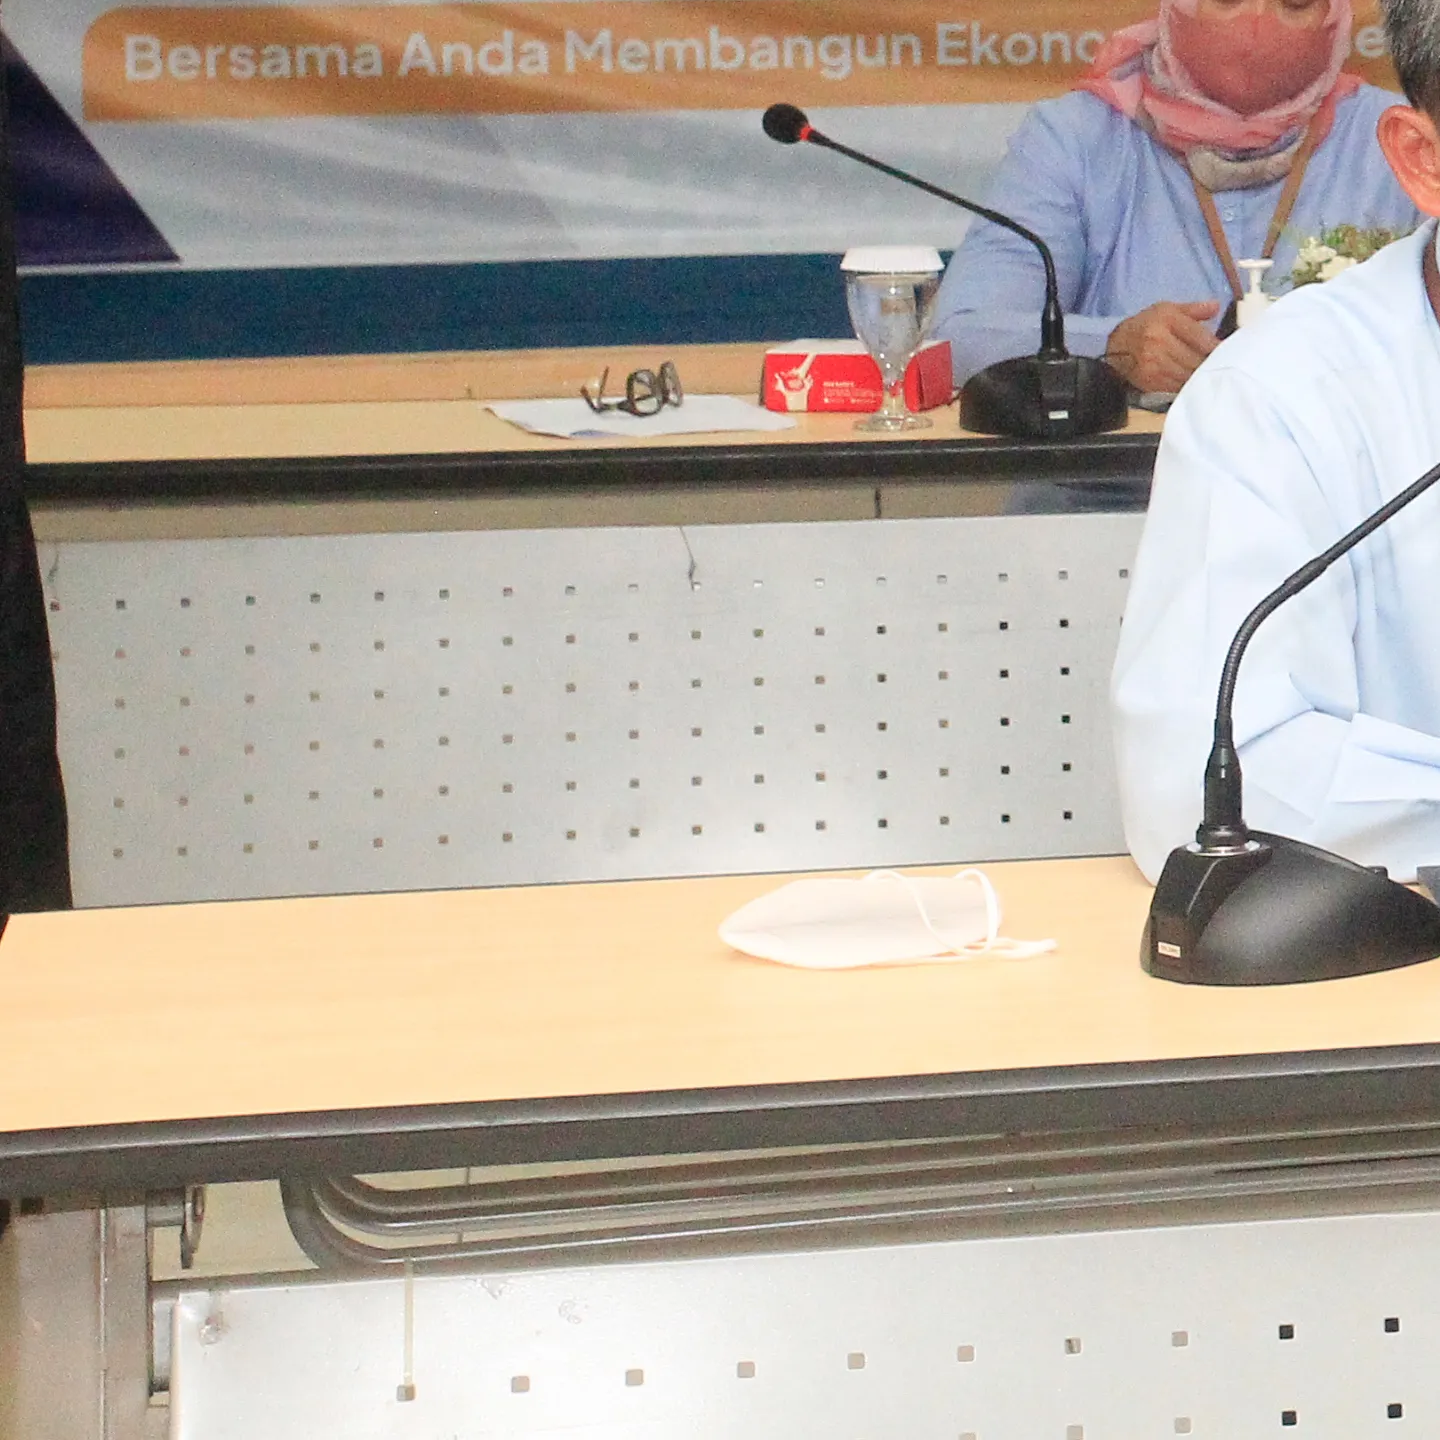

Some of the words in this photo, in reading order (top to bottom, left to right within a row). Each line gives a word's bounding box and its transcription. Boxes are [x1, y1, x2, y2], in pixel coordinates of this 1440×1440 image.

[124, 34, 382, 80] Bersama
[399, 31, 549, 77] Anda
[565, 24, 922, 78] Membangun
[935, 21, 1104, 66] Ekono
